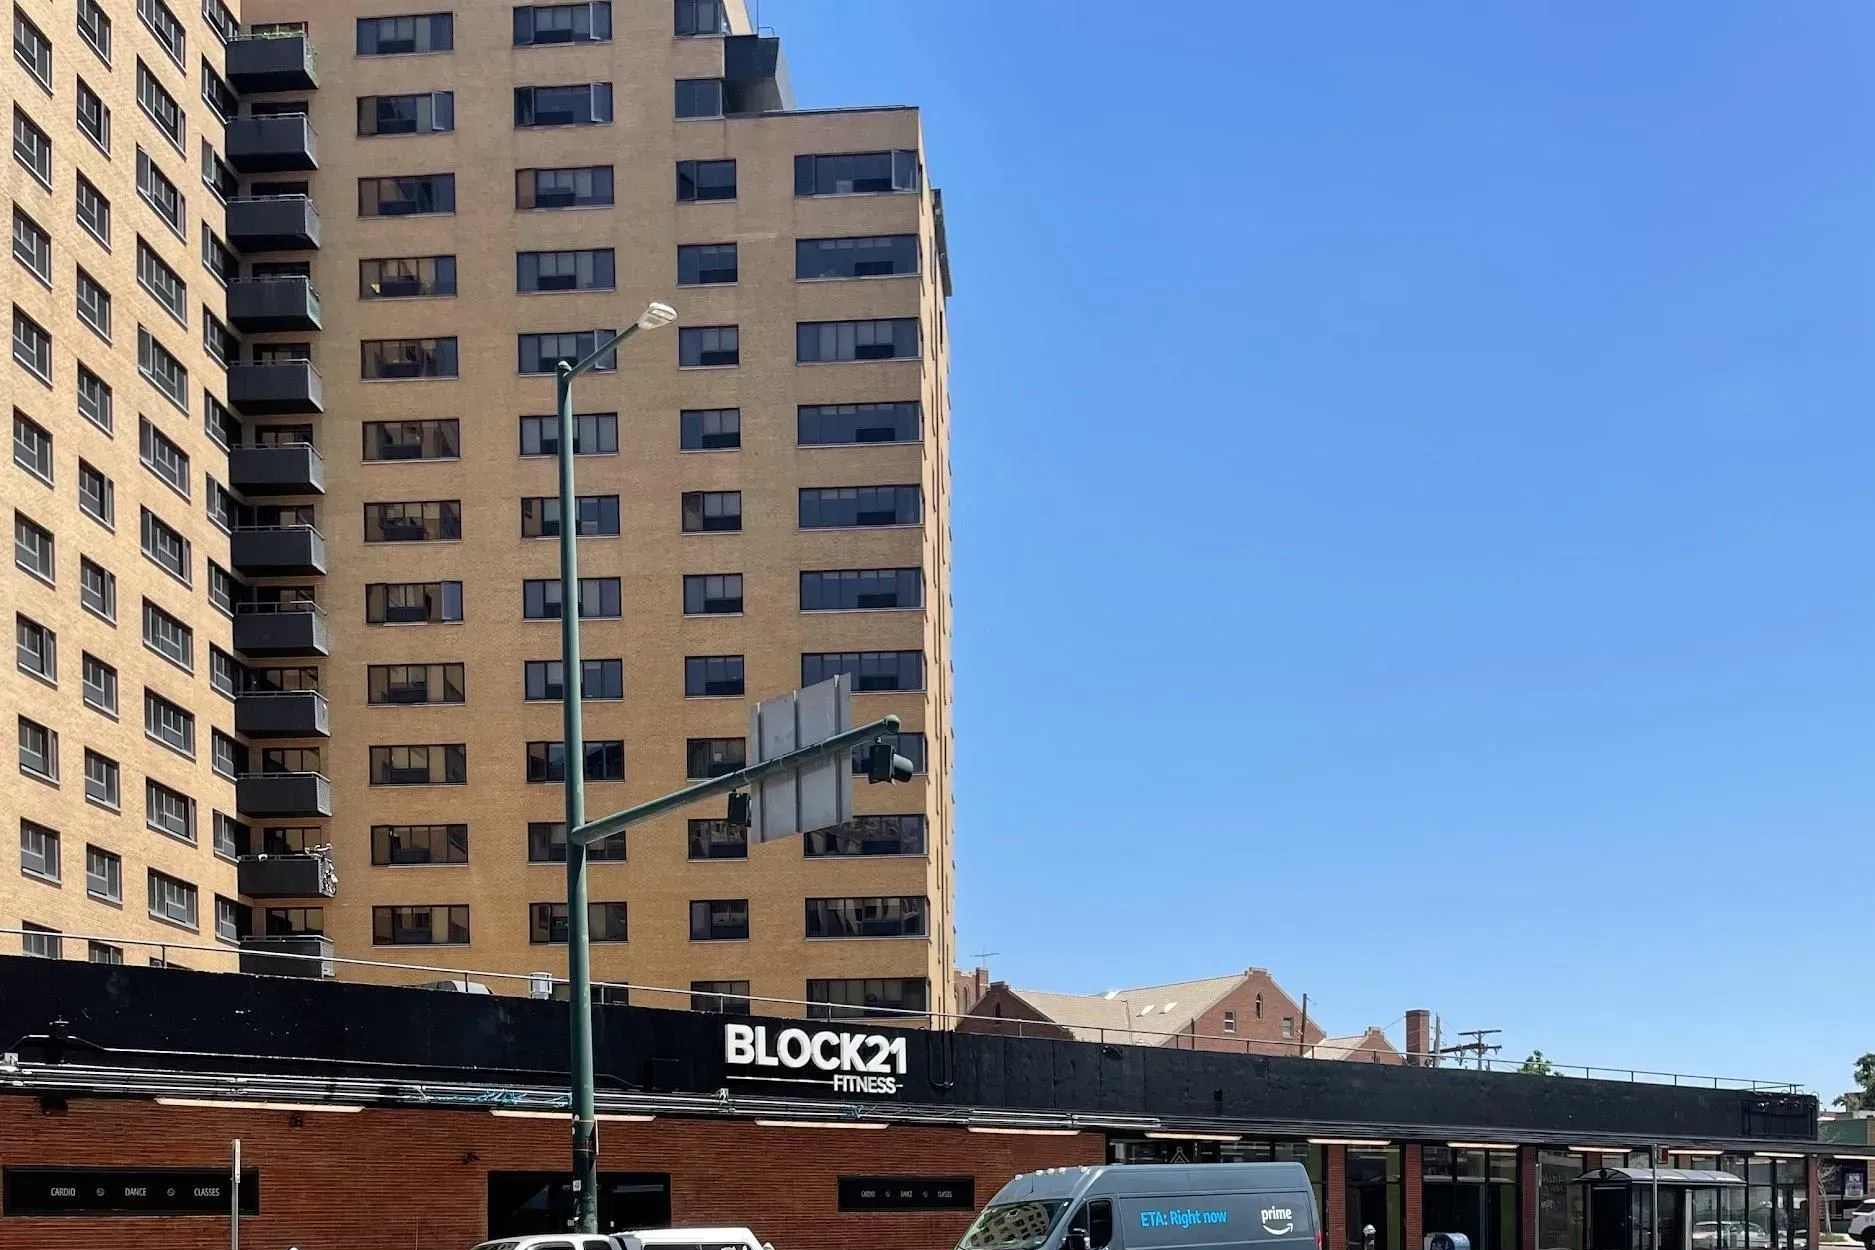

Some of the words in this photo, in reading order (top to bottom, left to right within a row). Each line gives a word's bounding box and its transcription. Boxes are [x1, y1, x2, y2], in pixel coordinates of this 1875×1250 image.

[725, 1024, 907, 1074] BLOCK21
[833, 1074, 896, 1093] FITNESS
[50, 1187, 76, 1197] CARDIO
[125, 1187, 147, 1196] DANCE
[194, 1187, 220, 1197] CLASSES
[1140, 1211, 1168, 1227] ETA:
[1170, 1209, 1200, 1228] Right
[1203, 1210, 1227, 1223] now
[1261, 1205, 1292, 1223] prime
